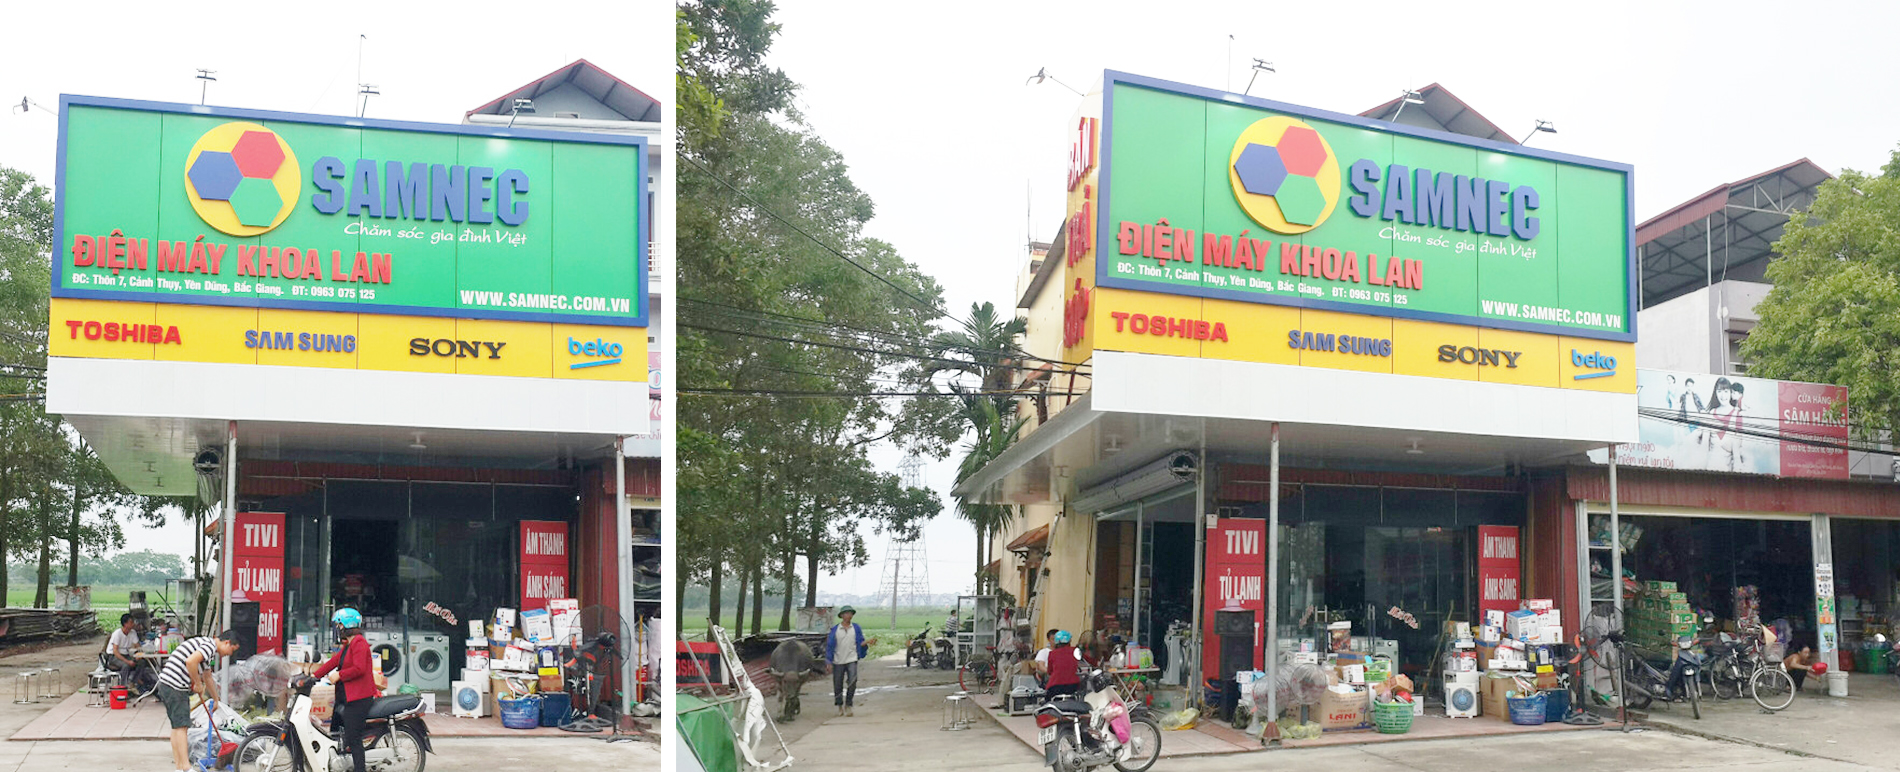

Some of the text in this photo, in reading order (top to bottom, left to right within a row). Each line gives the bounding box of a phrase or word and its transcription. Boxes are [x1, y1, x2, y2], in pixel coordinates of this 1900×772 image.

[312, 156, 529, 226] SAMNEC
[1347, 158, 1540, 241] SAMNEC
[344, 221, 527, 247] Chăm sóc gia đình Việt
[1378, 227, 1537, 261] Chăm sóc gia đình Việt
[72, 229, 392, 284] ĐIỆN MÁY KHOA LAN
[1117, 217, 1423, 290] ĐIỆN MÁY KHOA LAN
[72, 273, 90, 284] ĐC:
[93, 274, 116, 286] Thôn
[118, 275, 127, 288] 7,
[184, 279, 202, 290] Yên
[234, 280, 252, 293] Bắc
[255, 283, 284, 297] Giang.
[1117, 262, 1135, 274] ĐC:
[1138, 264, 1162, 277] Thôn
[1164, 267, 1173, 280] 7,
[1229, 273, 1246, 287] Yên
[1277, 280, 1295, 292] Bắc
[1298, 283, 1325, 297] Giang.
[292, 285, 376, 300] ĐT: 0963 075 125
[460, 290, 630, 313] WWW.SAMNEC.COM.VN
[1332, 287, 1408, 305] ĐT: 0963 075 125
[1111, 311, 1229, 342] TOSHIBA
[1482, 300, 1621, 328] WWW.SAMNEC.COM.VN
[66, 320, 182, 345] TOSHIBA
[409, 338, 507, 360] SONY
[567, 336, 623, 357] beko
[1438, 344, 1522, 368] SONY
[1571, 349, 1617, 370] beko
[1783, 407, 1809, 425] SÂM
[243, 523, 278, 548] TIVI
[539, 532, 564, 556] THANH
[1225, 530, 1259, 555] TIVI
[1495, 536, 1516, 559] THANH
[237, 560, 280, 596] TỦ LẠNH
[526, 570, 565, 599] ÁNH SÁNG
[1219, 568, 1261, 604] TỦ LẠNH
[1484, 573, 1516, 600] ÁNH SÁNG
